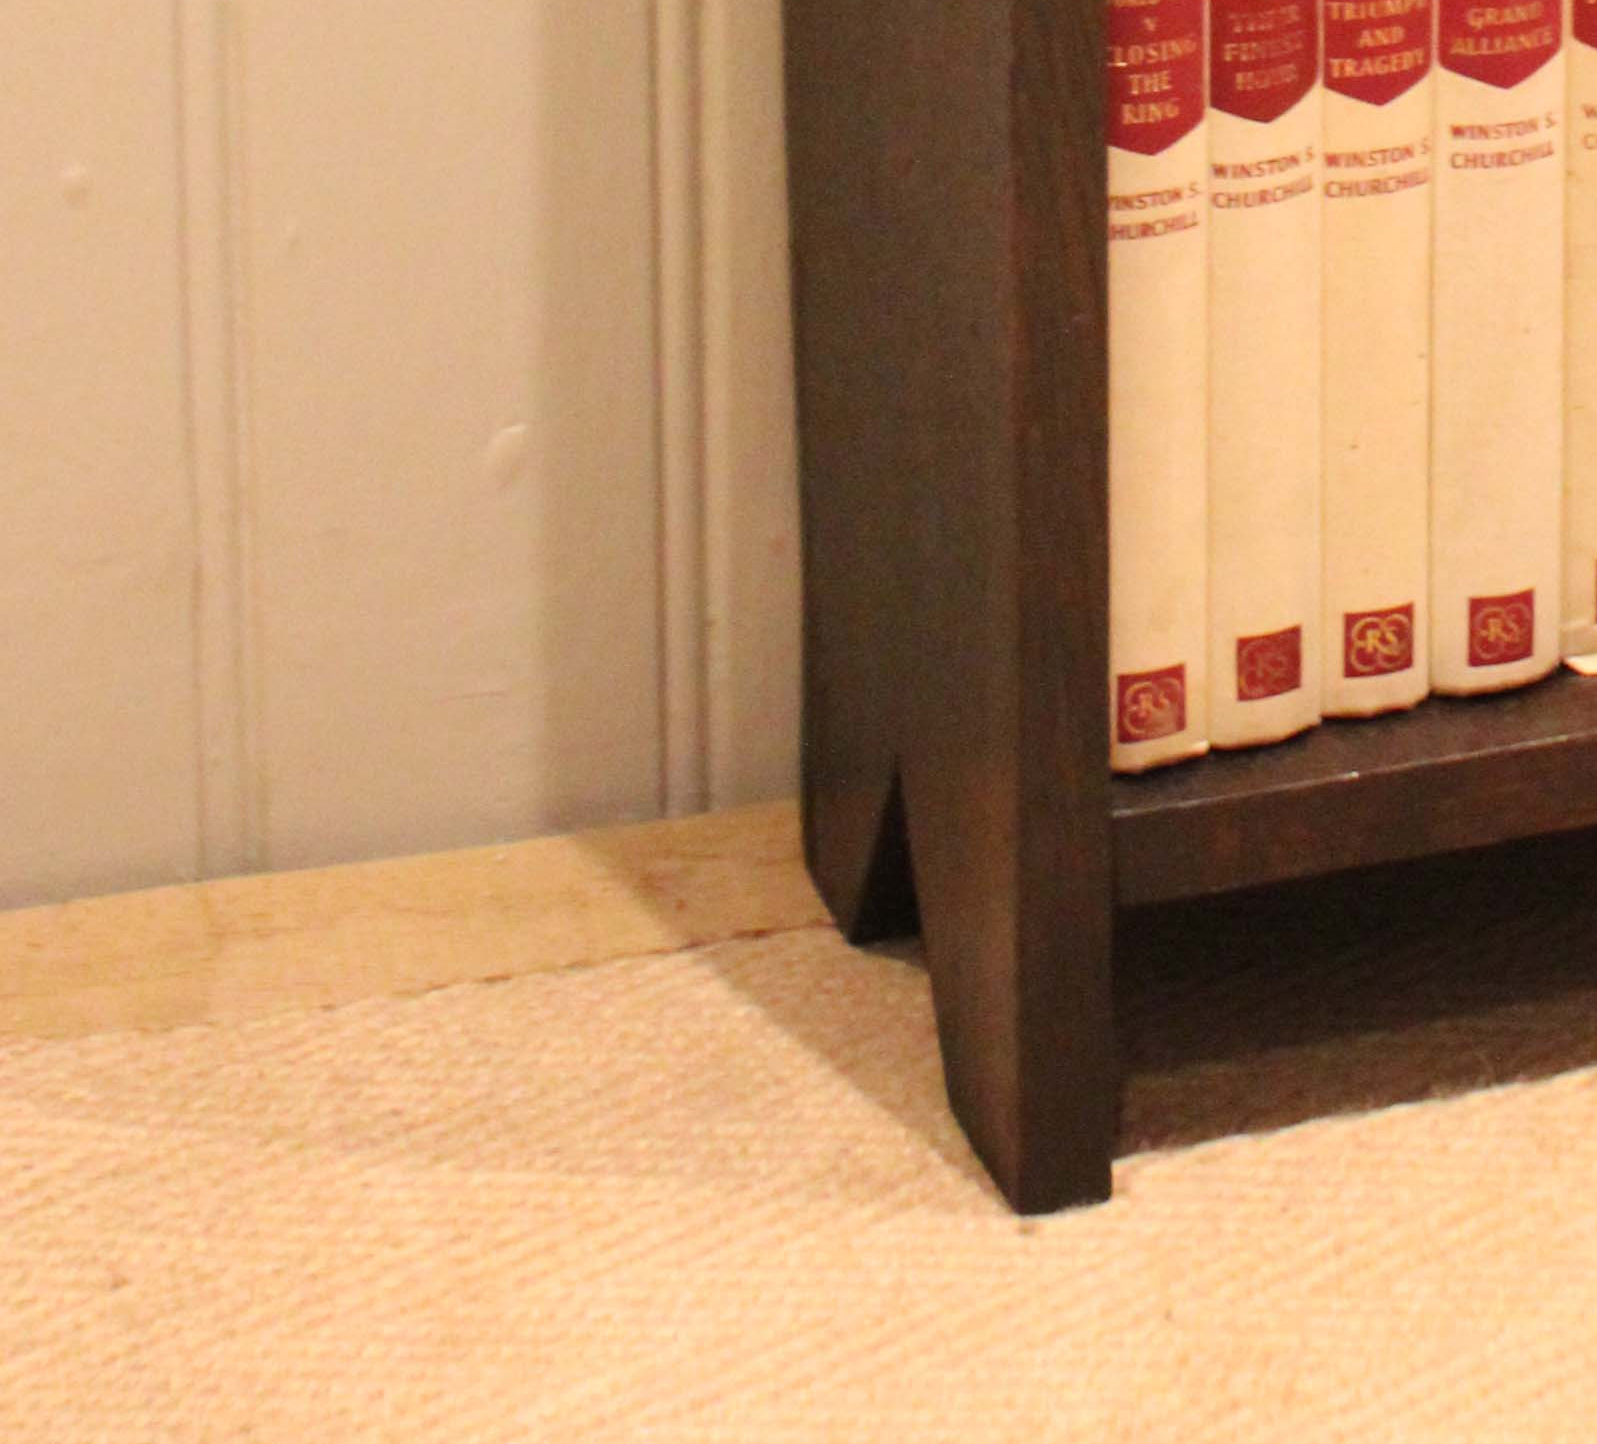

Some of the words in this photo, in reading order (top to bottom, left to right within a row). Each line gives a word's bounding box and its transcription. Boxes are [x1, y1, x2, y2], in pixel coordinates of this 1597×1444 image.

[1356, 24, 1406, 49] AND
[1449, 28, 1555, 58] ALLIANCE
[1327, 48, 1426, 79] TRAGEDY
[1128, 71, 1173, 96] THE
[1121, 99, 1180, 126] RING
[1450, 118, 1540, 142] WINSTON
[1211, 155, 1300, 181] WINSTON
[1324, 142, 1415, 170] WINSTON
[1450, 141, 1555, 171] CHURCHILL
